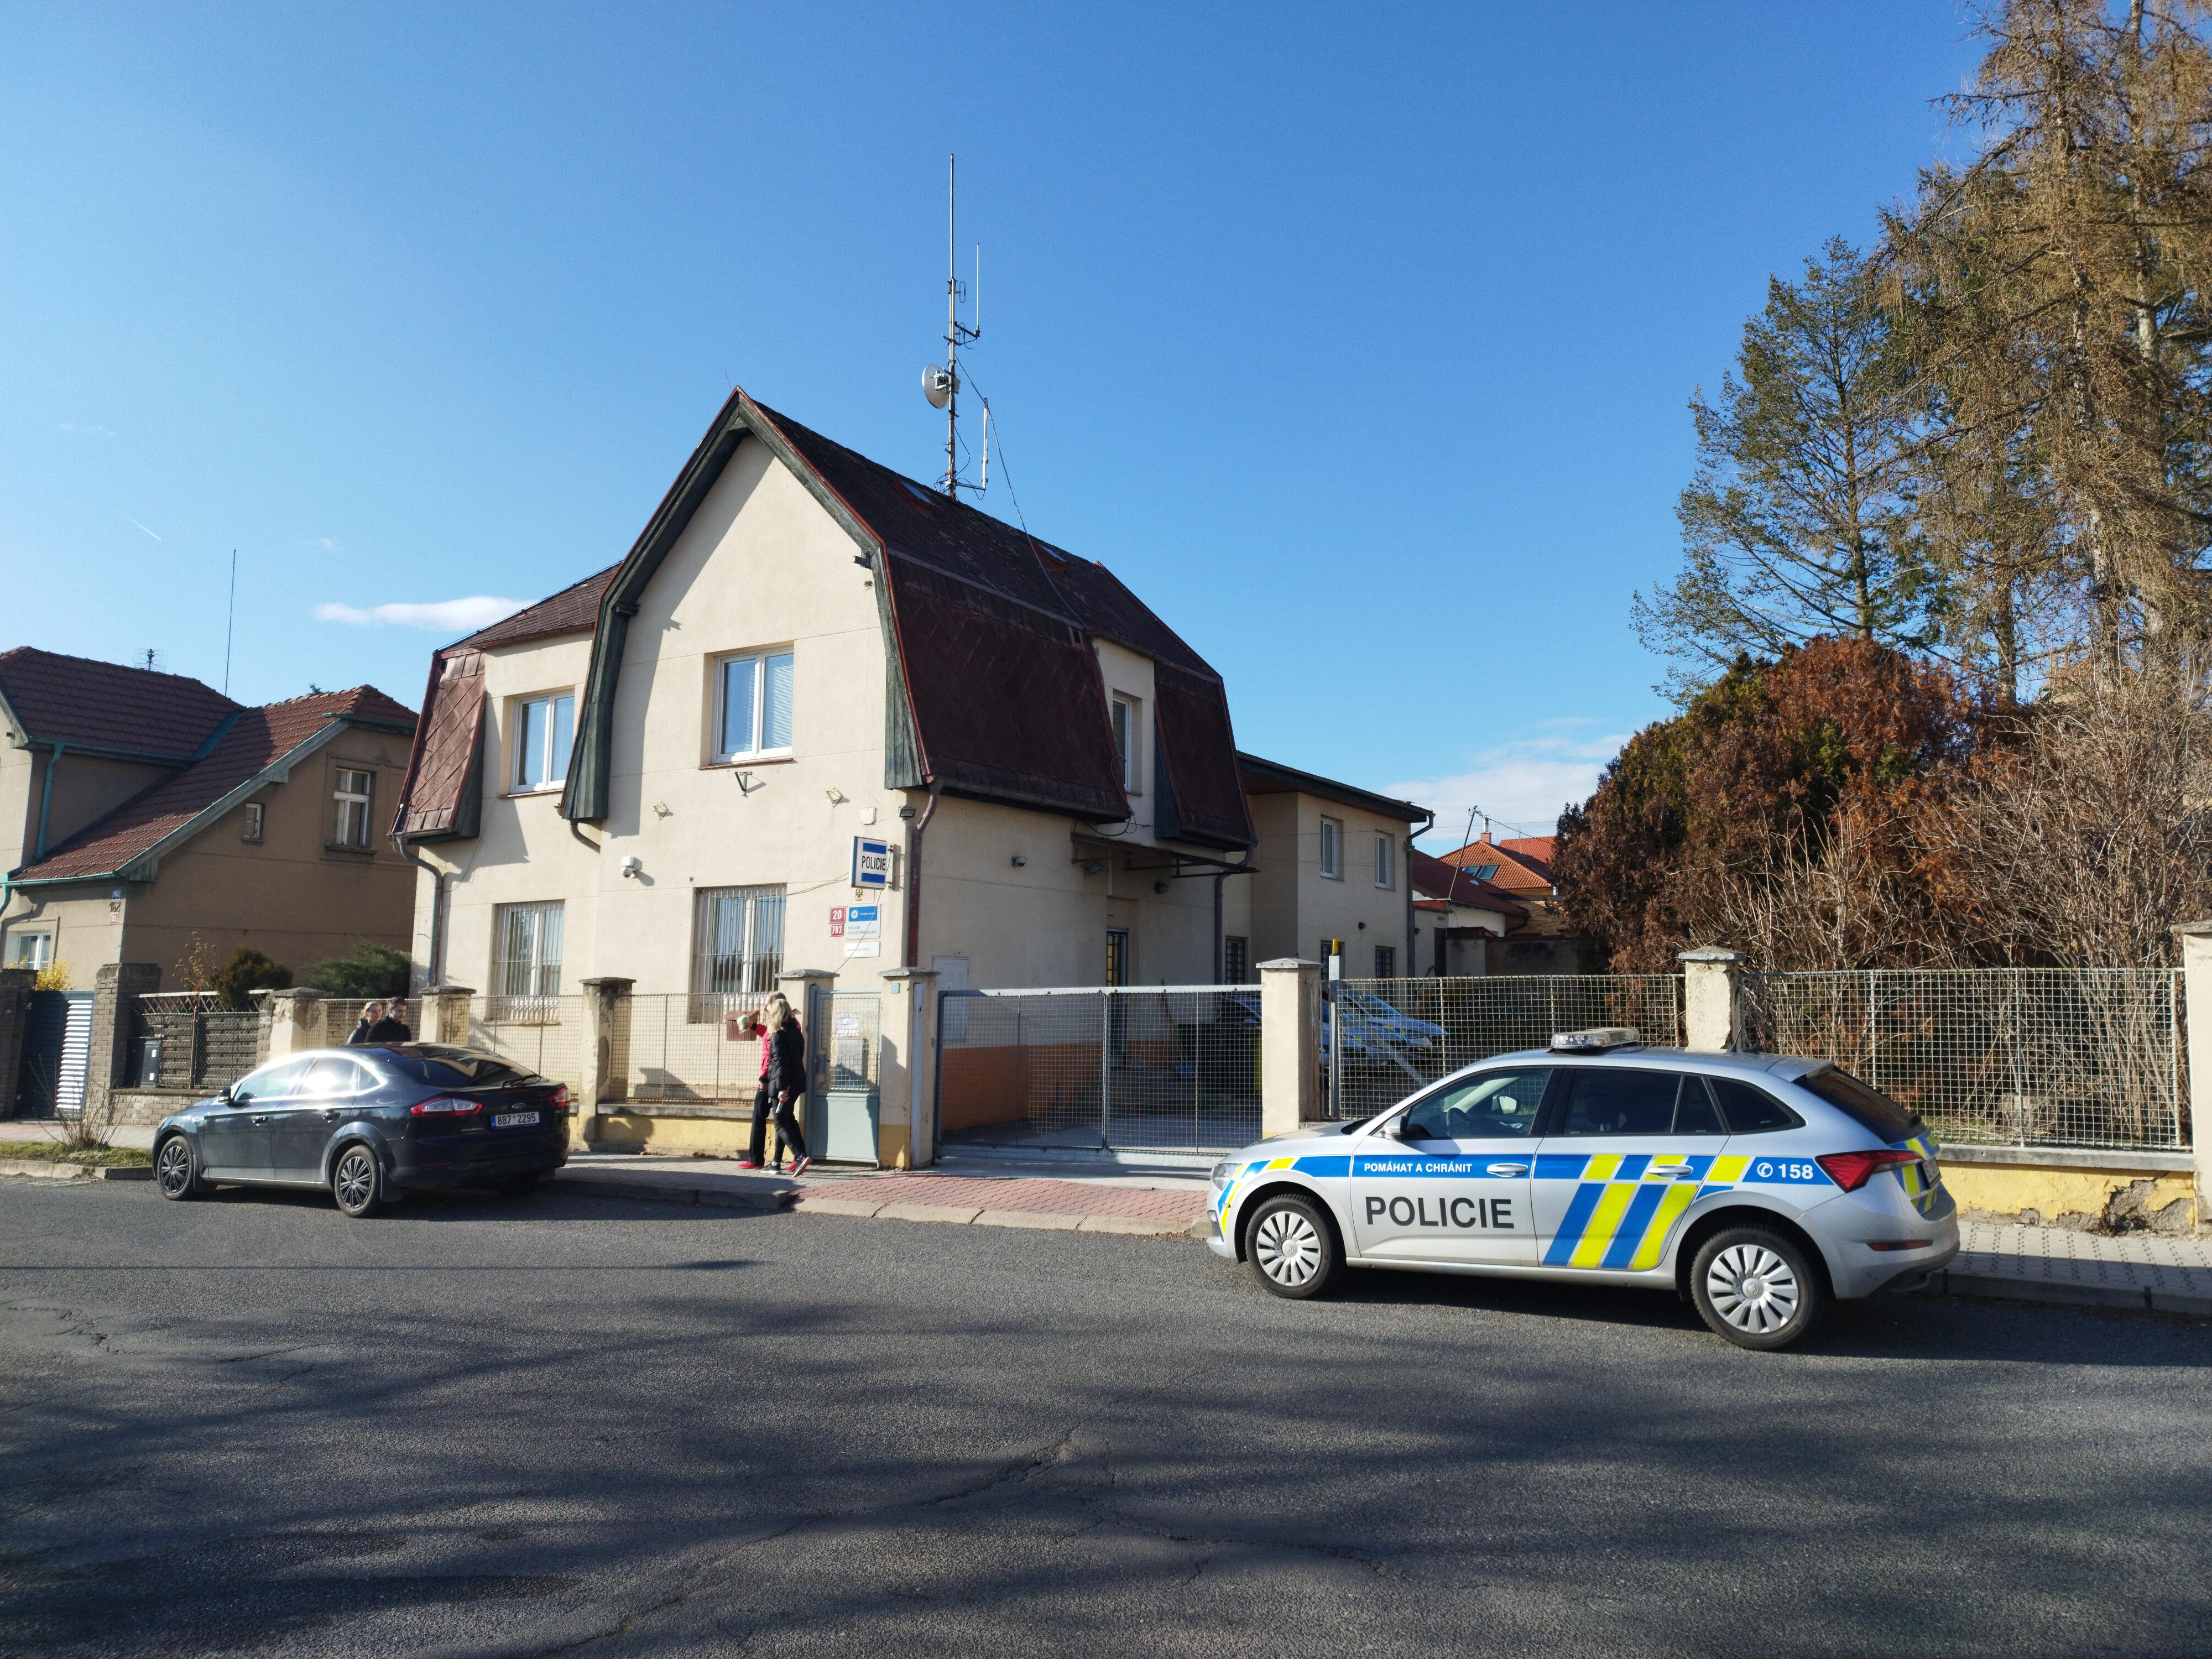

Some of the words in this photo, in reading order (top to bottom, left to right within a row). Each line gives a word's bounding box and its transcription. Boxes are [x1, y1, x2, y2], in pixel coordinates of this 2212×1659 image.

[862, 855, 886, 871] POLICIE
[109, 901, 121, 912] 162
[832, 910, 842, 920] 20
[832, 925, 842, 935] 783
[498, 1115, 512, 1125] 8B7
[518, 1113, 536, 1124] 2295
[1364, 1161, 1413, 1172] POMÁHAT
[1415, 1163, 1423, 1172] A
[1425, 1161, 1473, 1173] CHRÁNIT
[1778, 1163, 1814, 1180] 158
[1365, 1196, 1514, 1229] POLICIE
